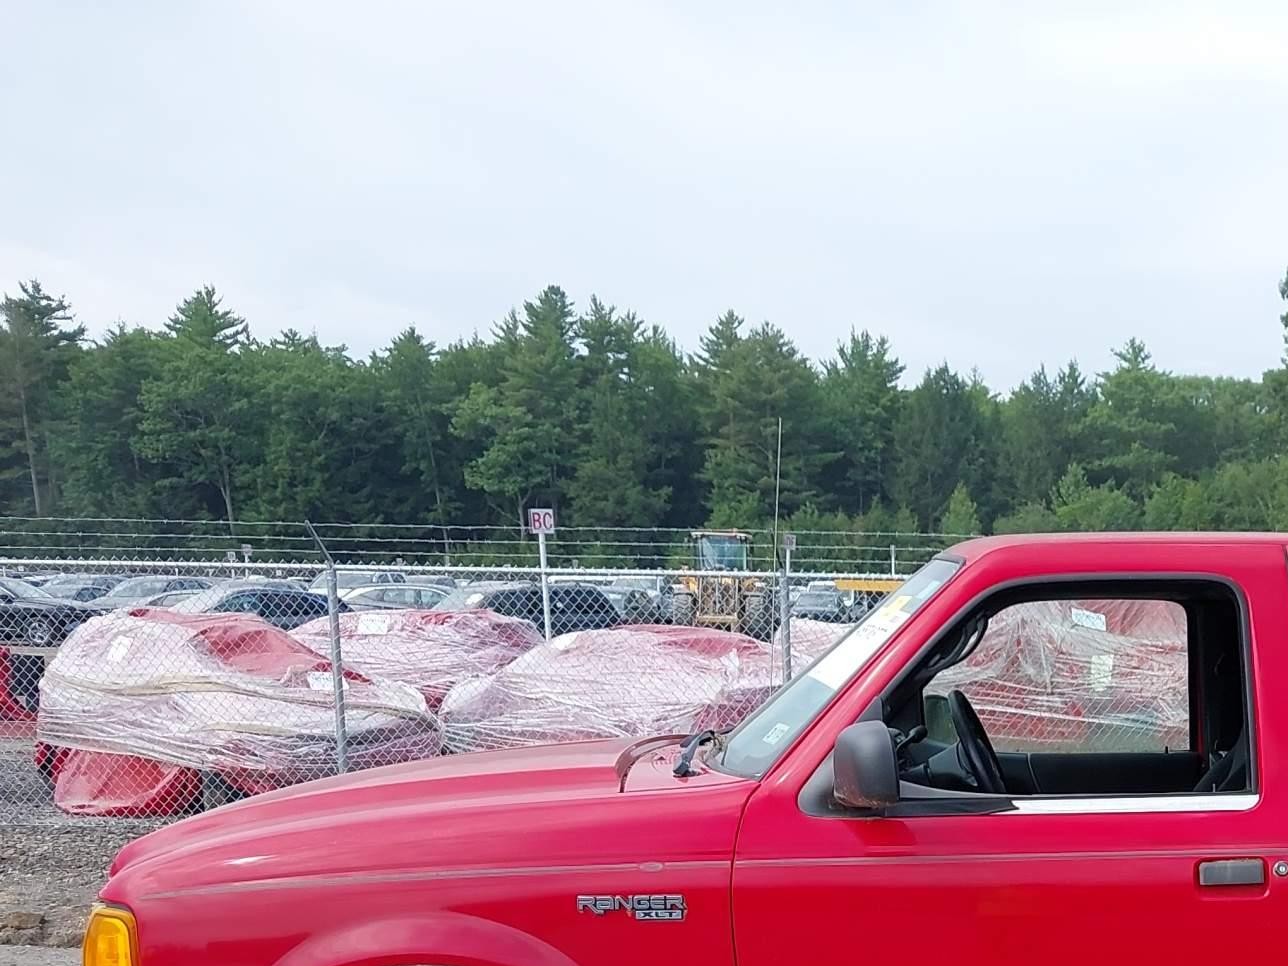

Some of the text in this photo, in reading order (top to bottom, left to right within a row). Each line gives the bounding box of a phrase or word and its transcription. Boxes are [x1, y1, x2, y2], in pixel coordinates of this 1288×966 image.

[532, 512, 553, 530] BC
[576, 894, 686, 915] RANGER
[639, 910, 679, 919] XLT
